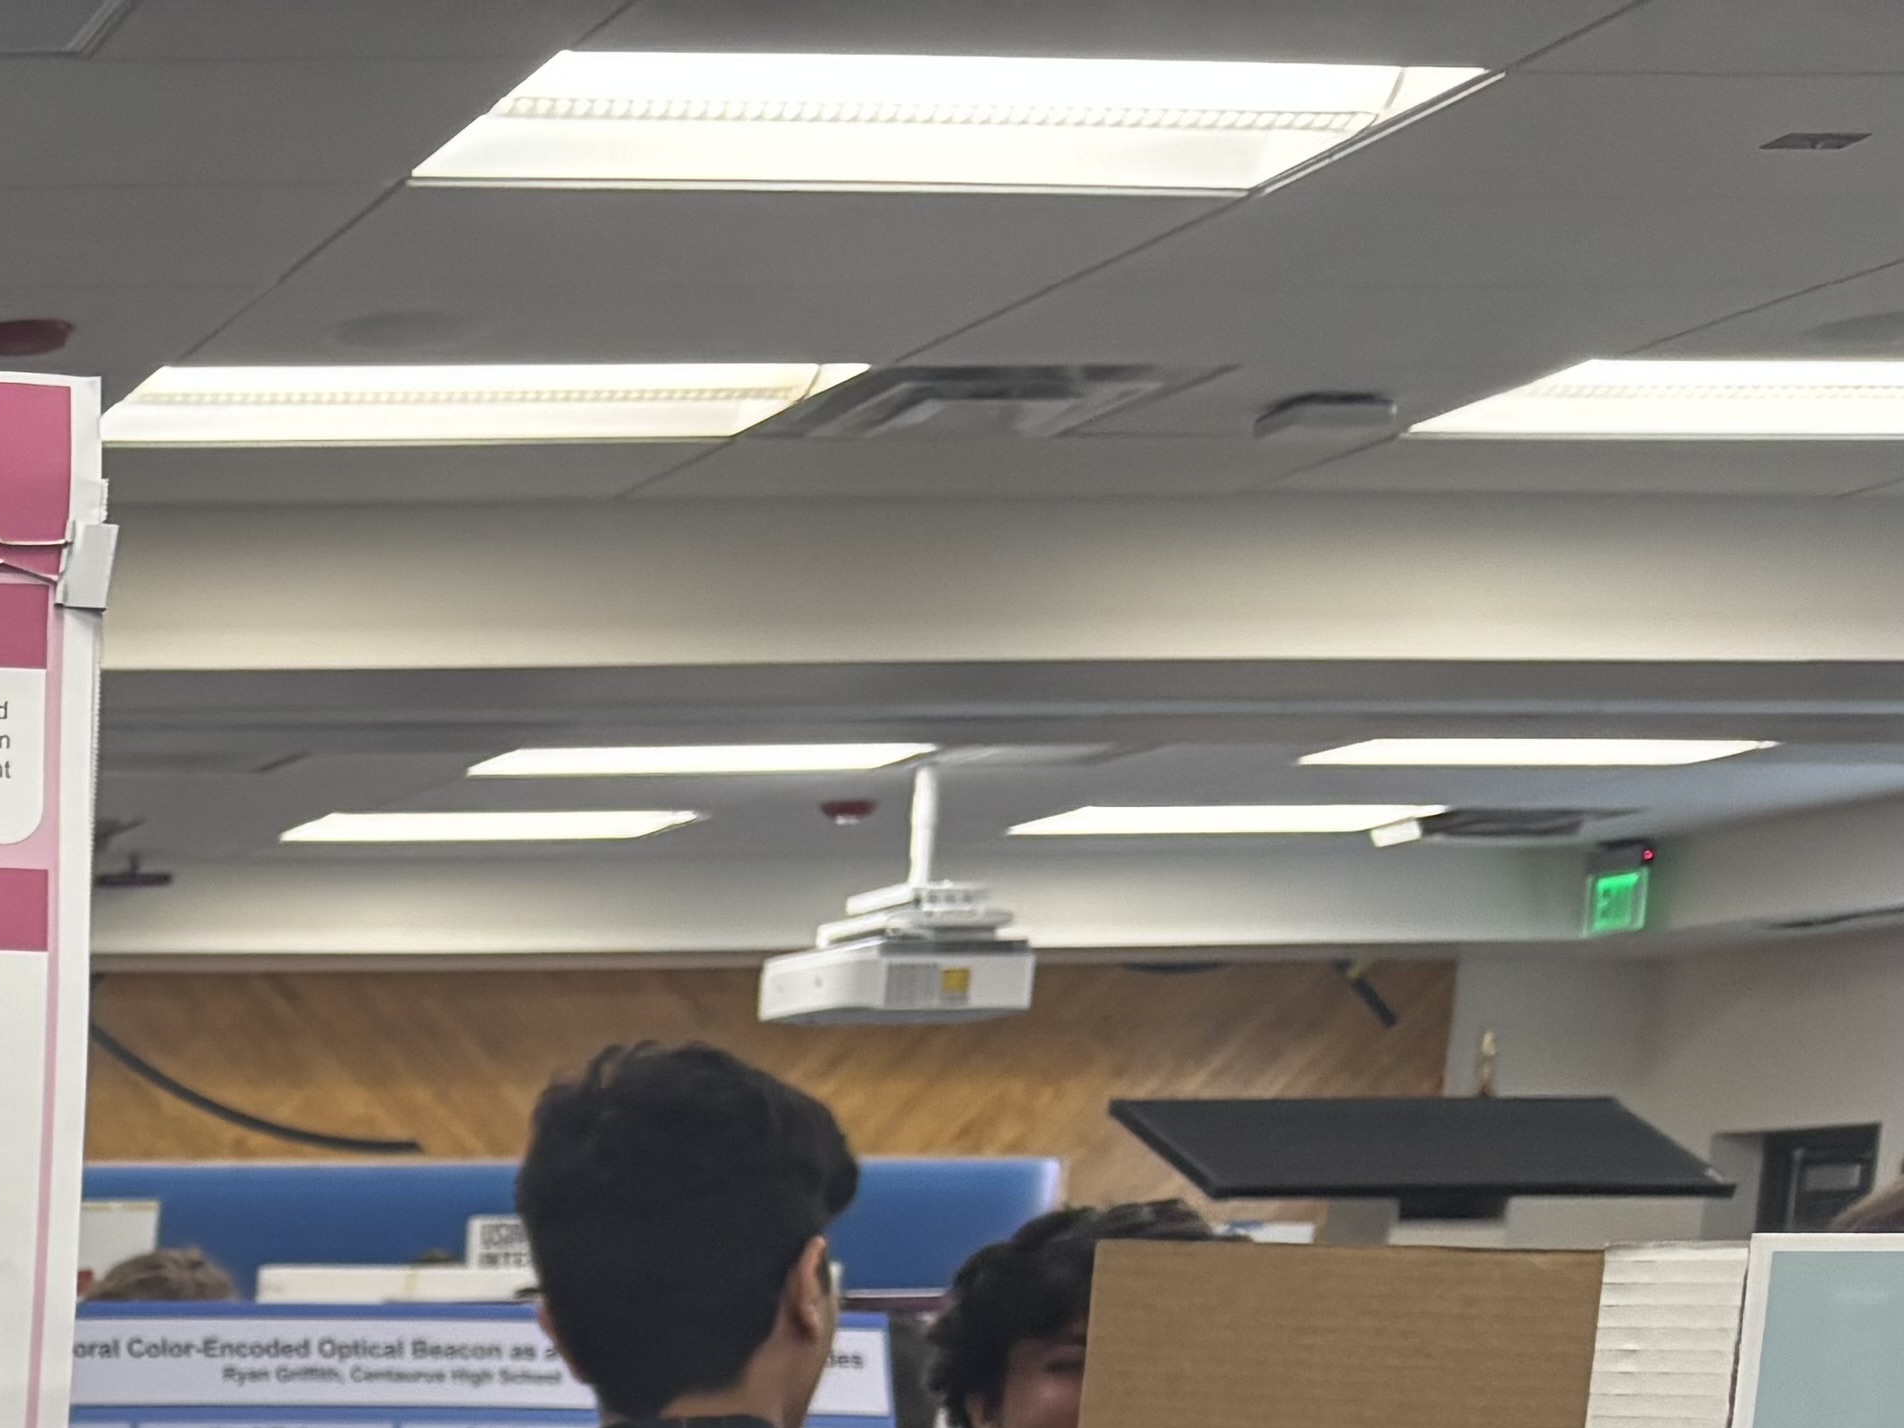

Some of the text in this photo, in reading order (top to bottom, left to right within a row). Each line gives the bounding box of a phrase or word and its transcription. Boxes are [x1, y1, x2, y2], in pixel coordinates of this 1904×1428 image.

[127, 1337, 311, 1360] Color-Encoded
[318, 1339, 403, 1361] Optical
[413, 1339, 502, 1360] Beacon
[510, 1344, 536, 1361] as
